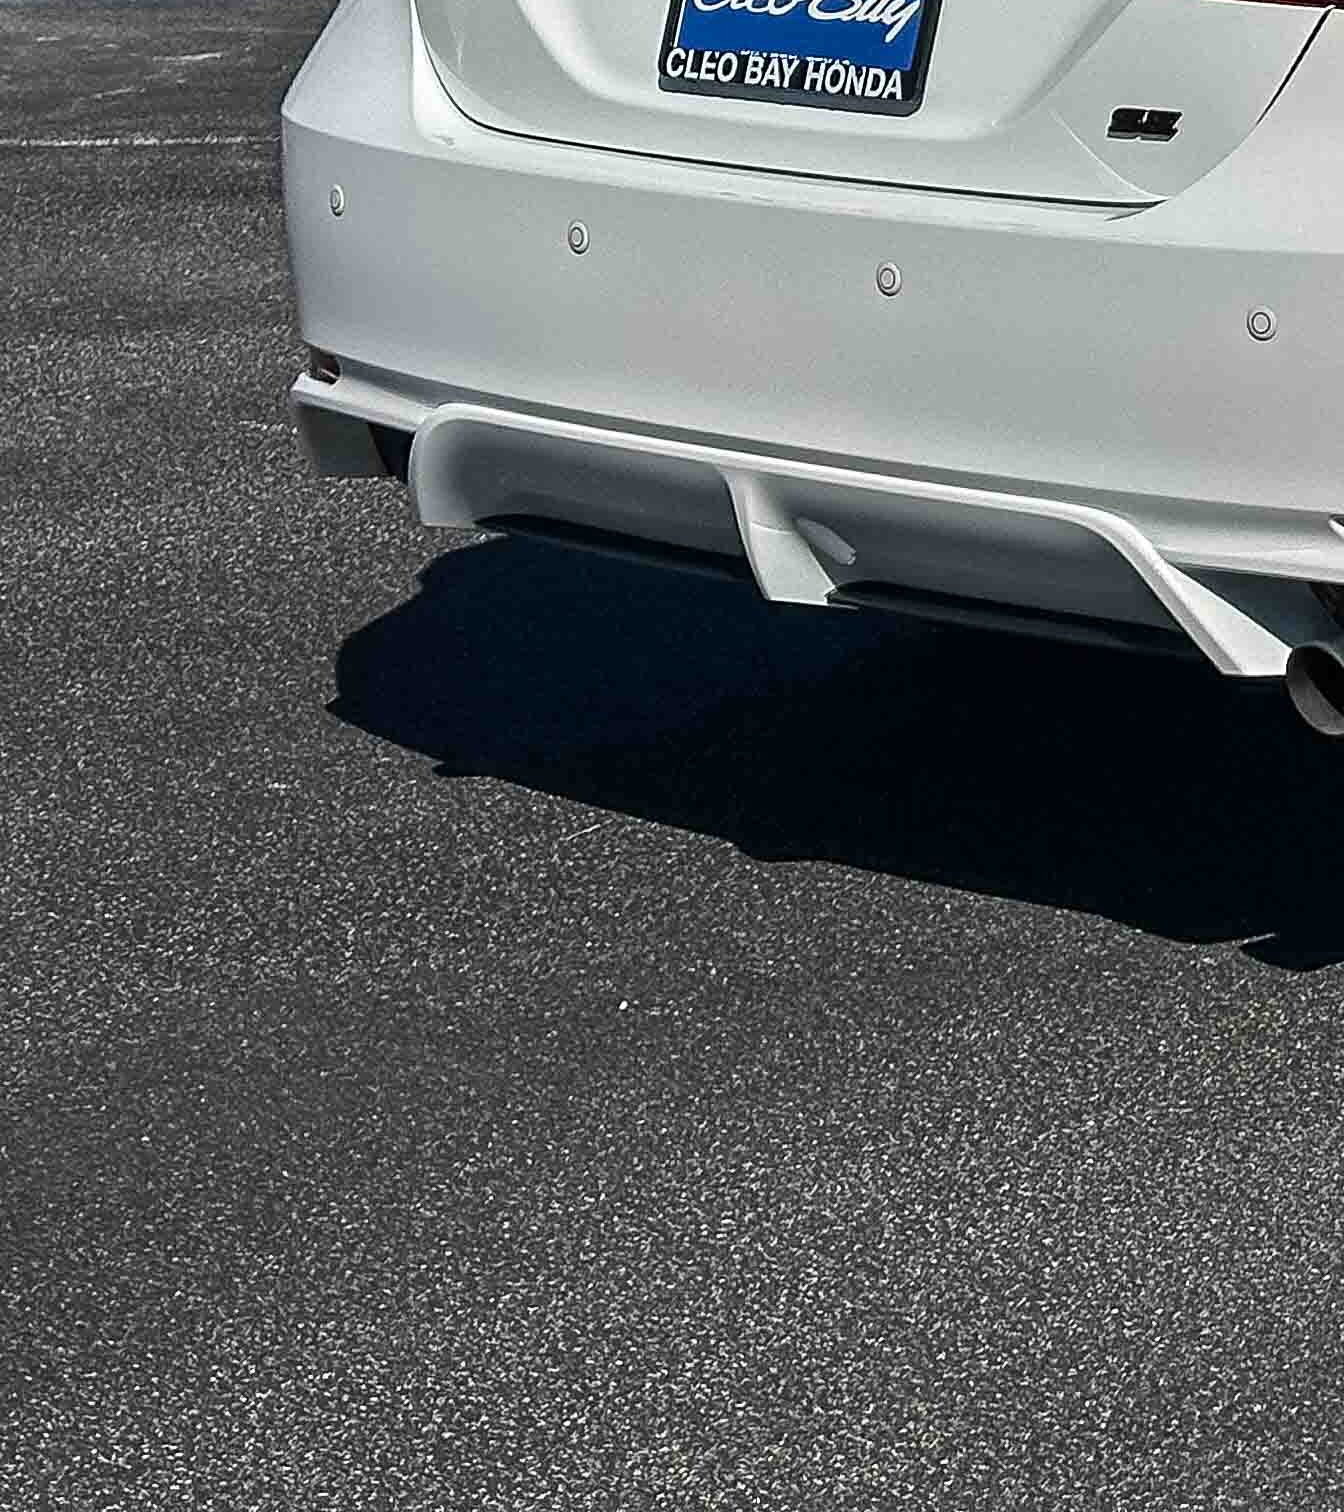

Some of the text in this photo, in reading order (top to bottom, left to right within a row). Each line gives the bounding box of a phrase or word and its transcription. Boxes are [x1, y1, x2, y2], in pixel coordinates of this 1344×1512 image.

[665, 47, 738, 83] CLEO
[743, 54, 800, 89] BAY
[803, 59, 903, 101] HONDA
